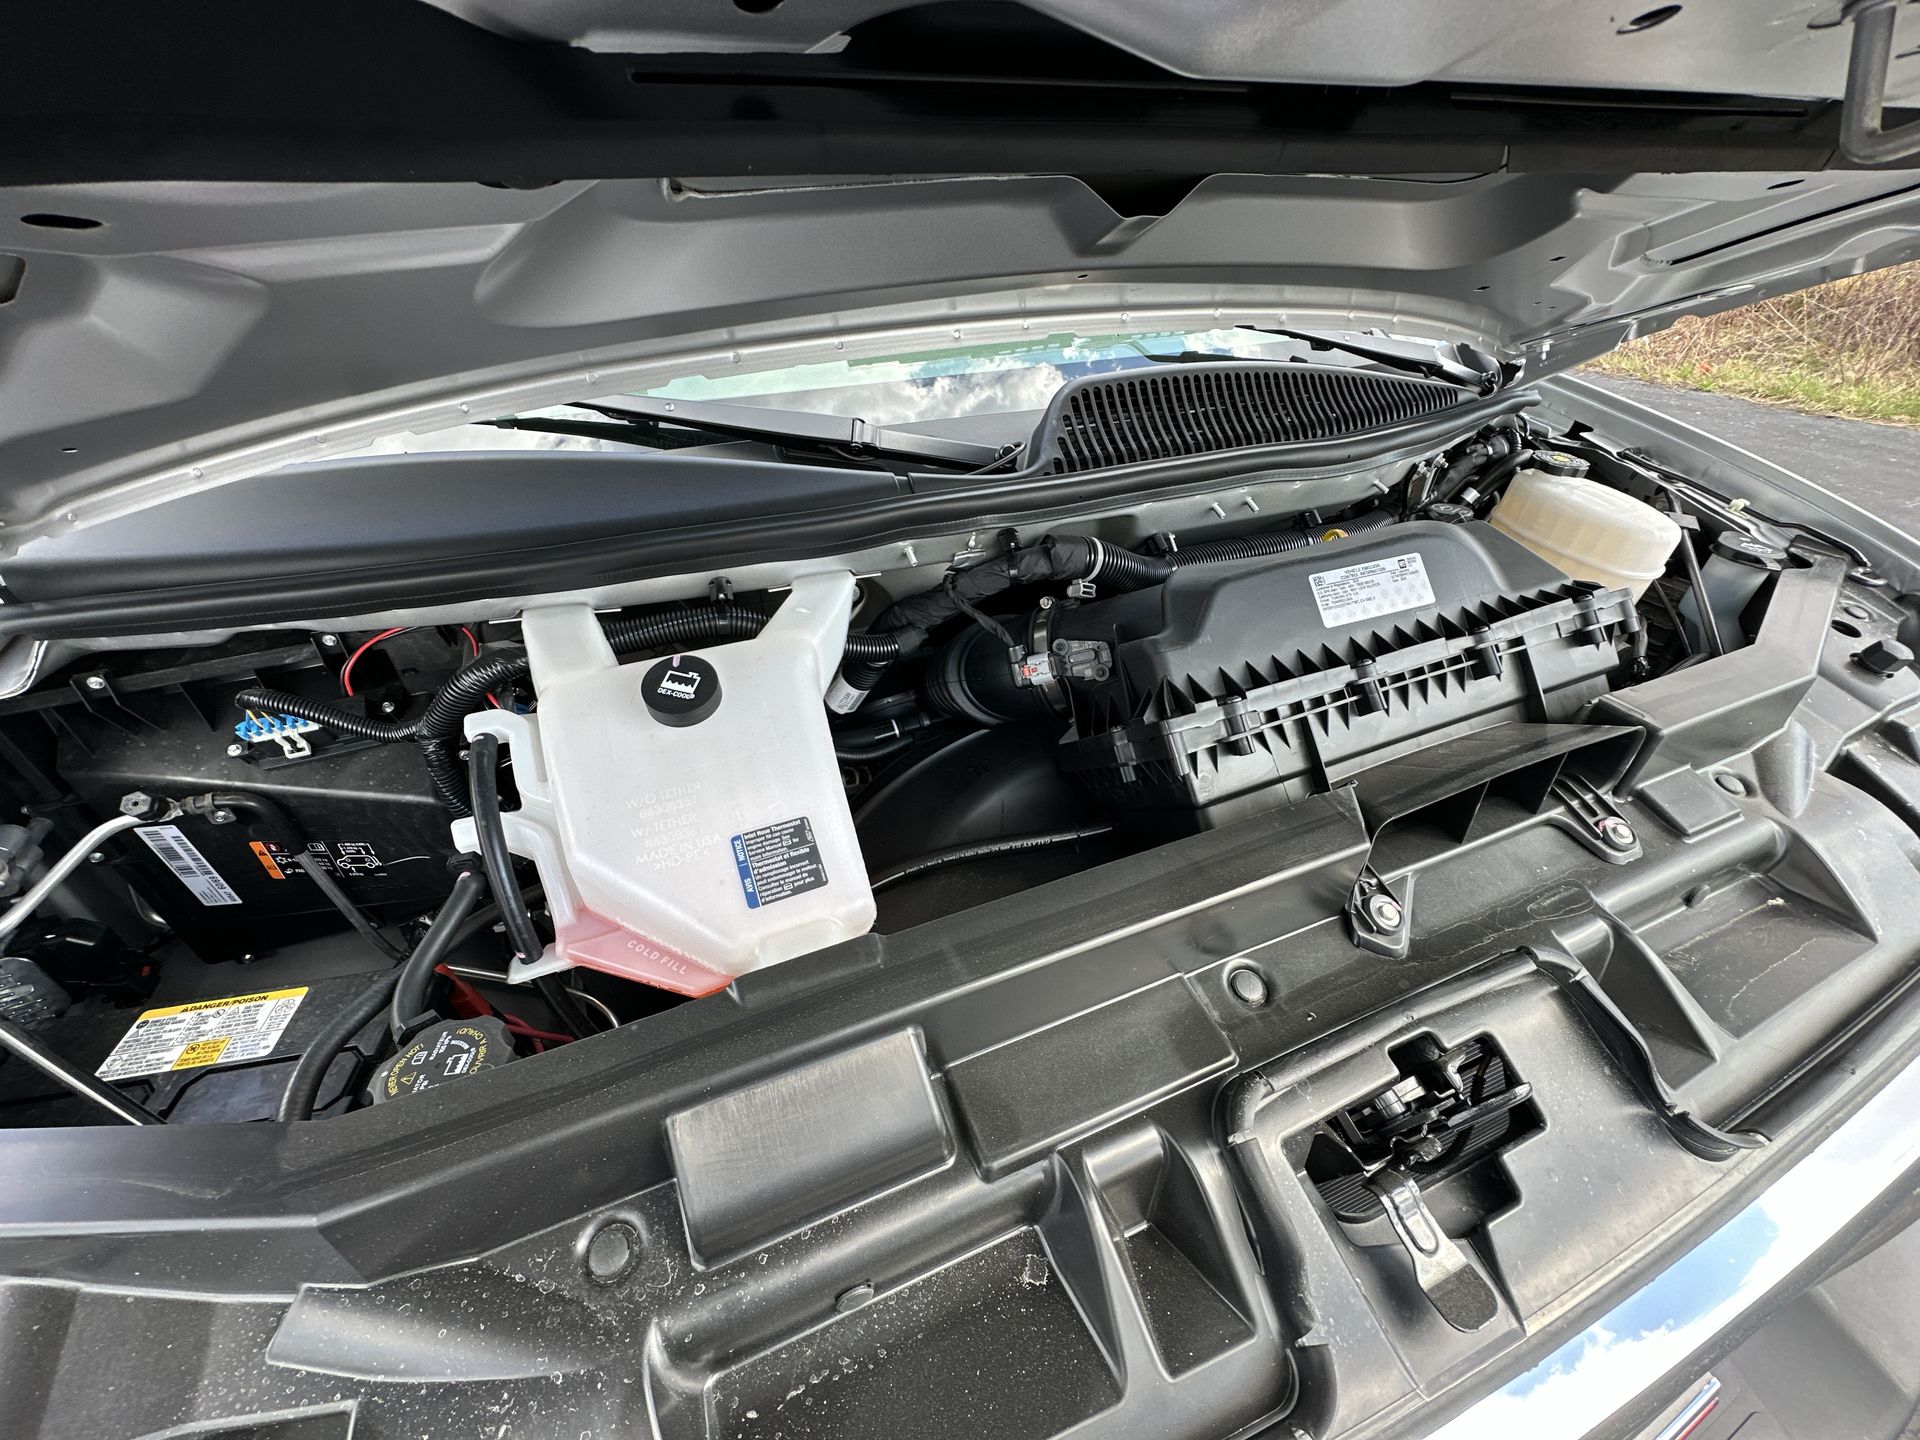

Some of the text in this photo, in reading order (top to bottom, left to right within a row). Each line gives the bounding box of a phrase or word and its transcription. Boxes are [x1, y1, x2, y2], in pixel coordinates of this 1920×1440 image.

[771, 819, 800, 831] Thermostat
[734, 840, 745, 861] NOTICE
[1023, 839, 1050, 848] GALAXY
[752, 855, 782, 868] Thermostat
[744, 877, 753, 892] AVIS
[627, 940, 688, 975] COLD FILL
[187, 994, 269, 1012] DANGER/POISON
[391, 1057, 407, 1077] OPEN
[405, 1044, 424, 1058] HOT!
